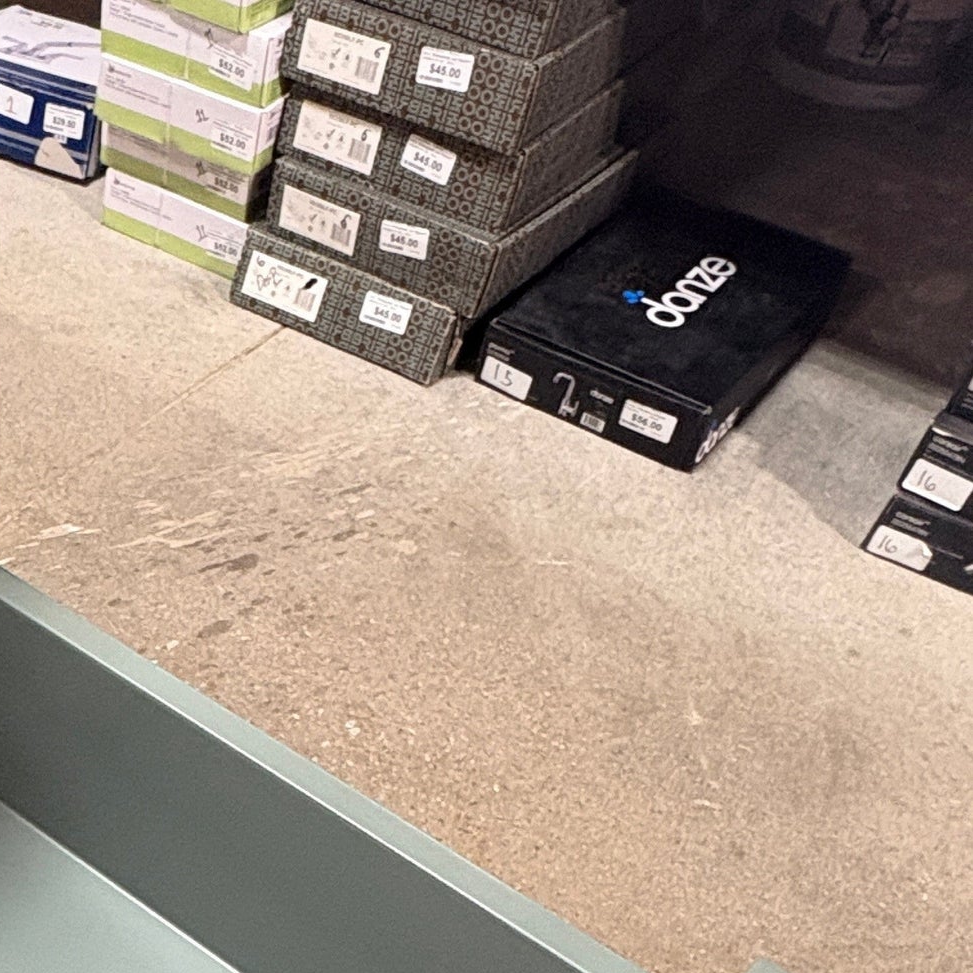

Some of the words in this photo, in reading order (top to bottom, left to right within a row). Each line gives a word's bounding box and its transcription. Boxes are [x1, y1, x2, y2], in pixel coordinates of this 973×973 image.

[373, 46, 387, 60] 6
[218, 58, 246, 79] $52.00
[429, 62, 462, 79] $45.00
[220, 132, 247, 150] $52.00
[360, 127, 373, 142] 6
[413, 150, 444, 173] $45.00
[390, 232, 420, 249] $45.00
[640, 256, 737, 328] danze
[373, 305, 404, 324] $45.00
[493, 362, 514, 387] 15
[916, 469, 937, 492] 16
[877, 534, 899, 554] 16
